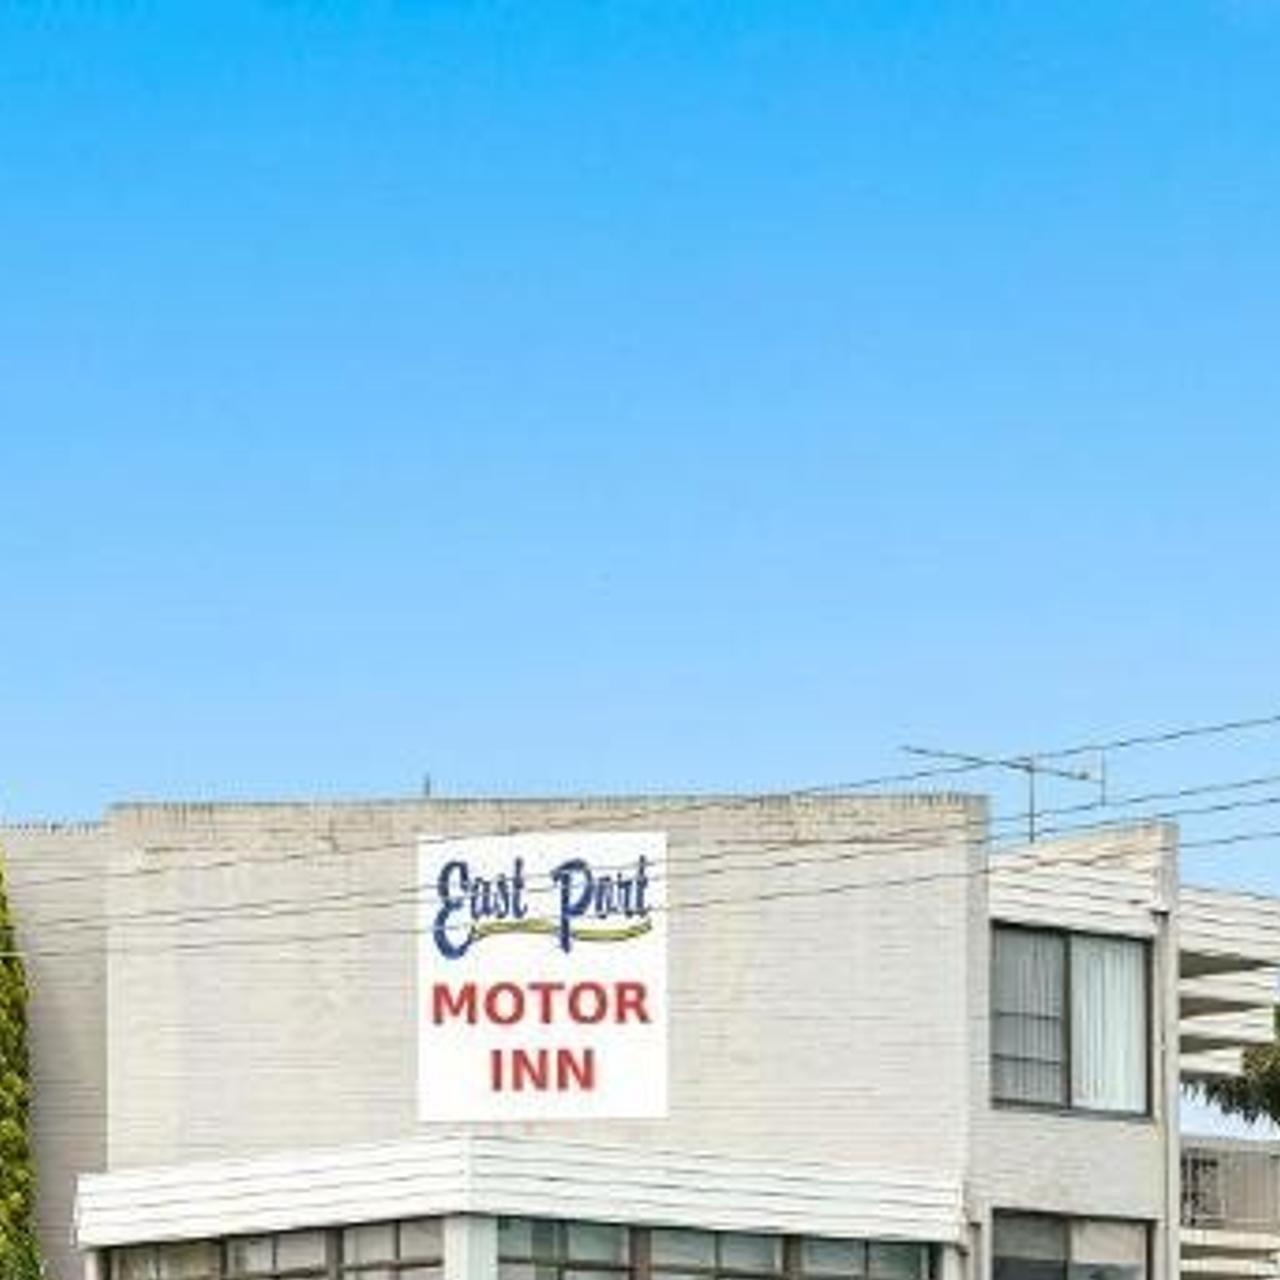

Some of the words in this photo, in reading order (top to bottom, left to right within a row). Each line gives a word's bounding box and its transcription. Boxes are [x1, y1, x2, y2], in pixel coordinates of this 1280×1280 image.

[433, 857, 528, 959] East
[550, 855, 651, 953] Port
[432, 981, 651, 1025] MOTOR
[491, 1048, 595, 1091] INN
